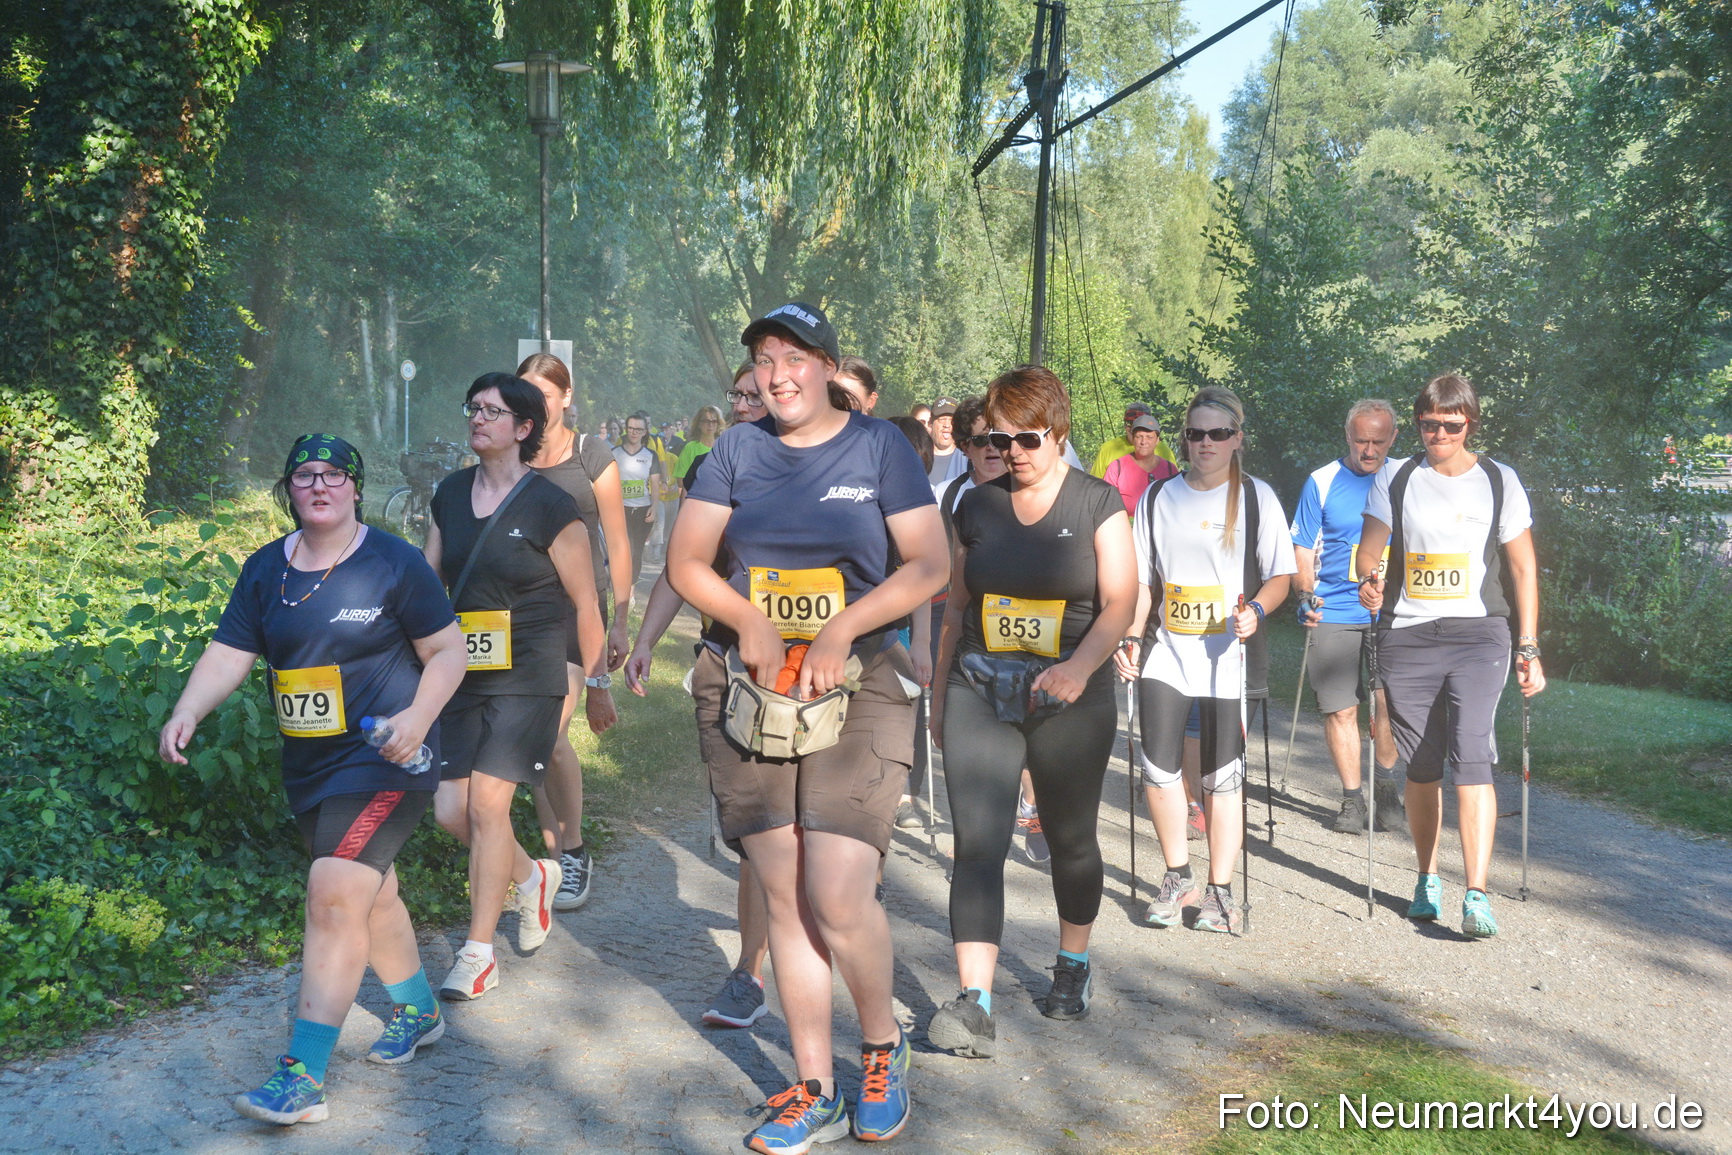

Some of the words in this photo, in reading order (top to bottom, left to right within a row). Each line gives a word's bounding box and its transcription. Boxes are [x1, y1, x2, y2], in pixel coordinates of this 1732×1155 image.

[622, 485, 642, 494] 1912
[819, 486, 860, 501] JURA
[1412, 569, 1460, 587] 2010
[330, 608, 371, 623] JURA
[761, 593, 831, 620] 1090
[1170, 601, 1214, 620] 2011
[998, 616, 1041, 639] 853
[466, 632, 493, 654] 55
[302, 717, 333, 726] Jeanette
